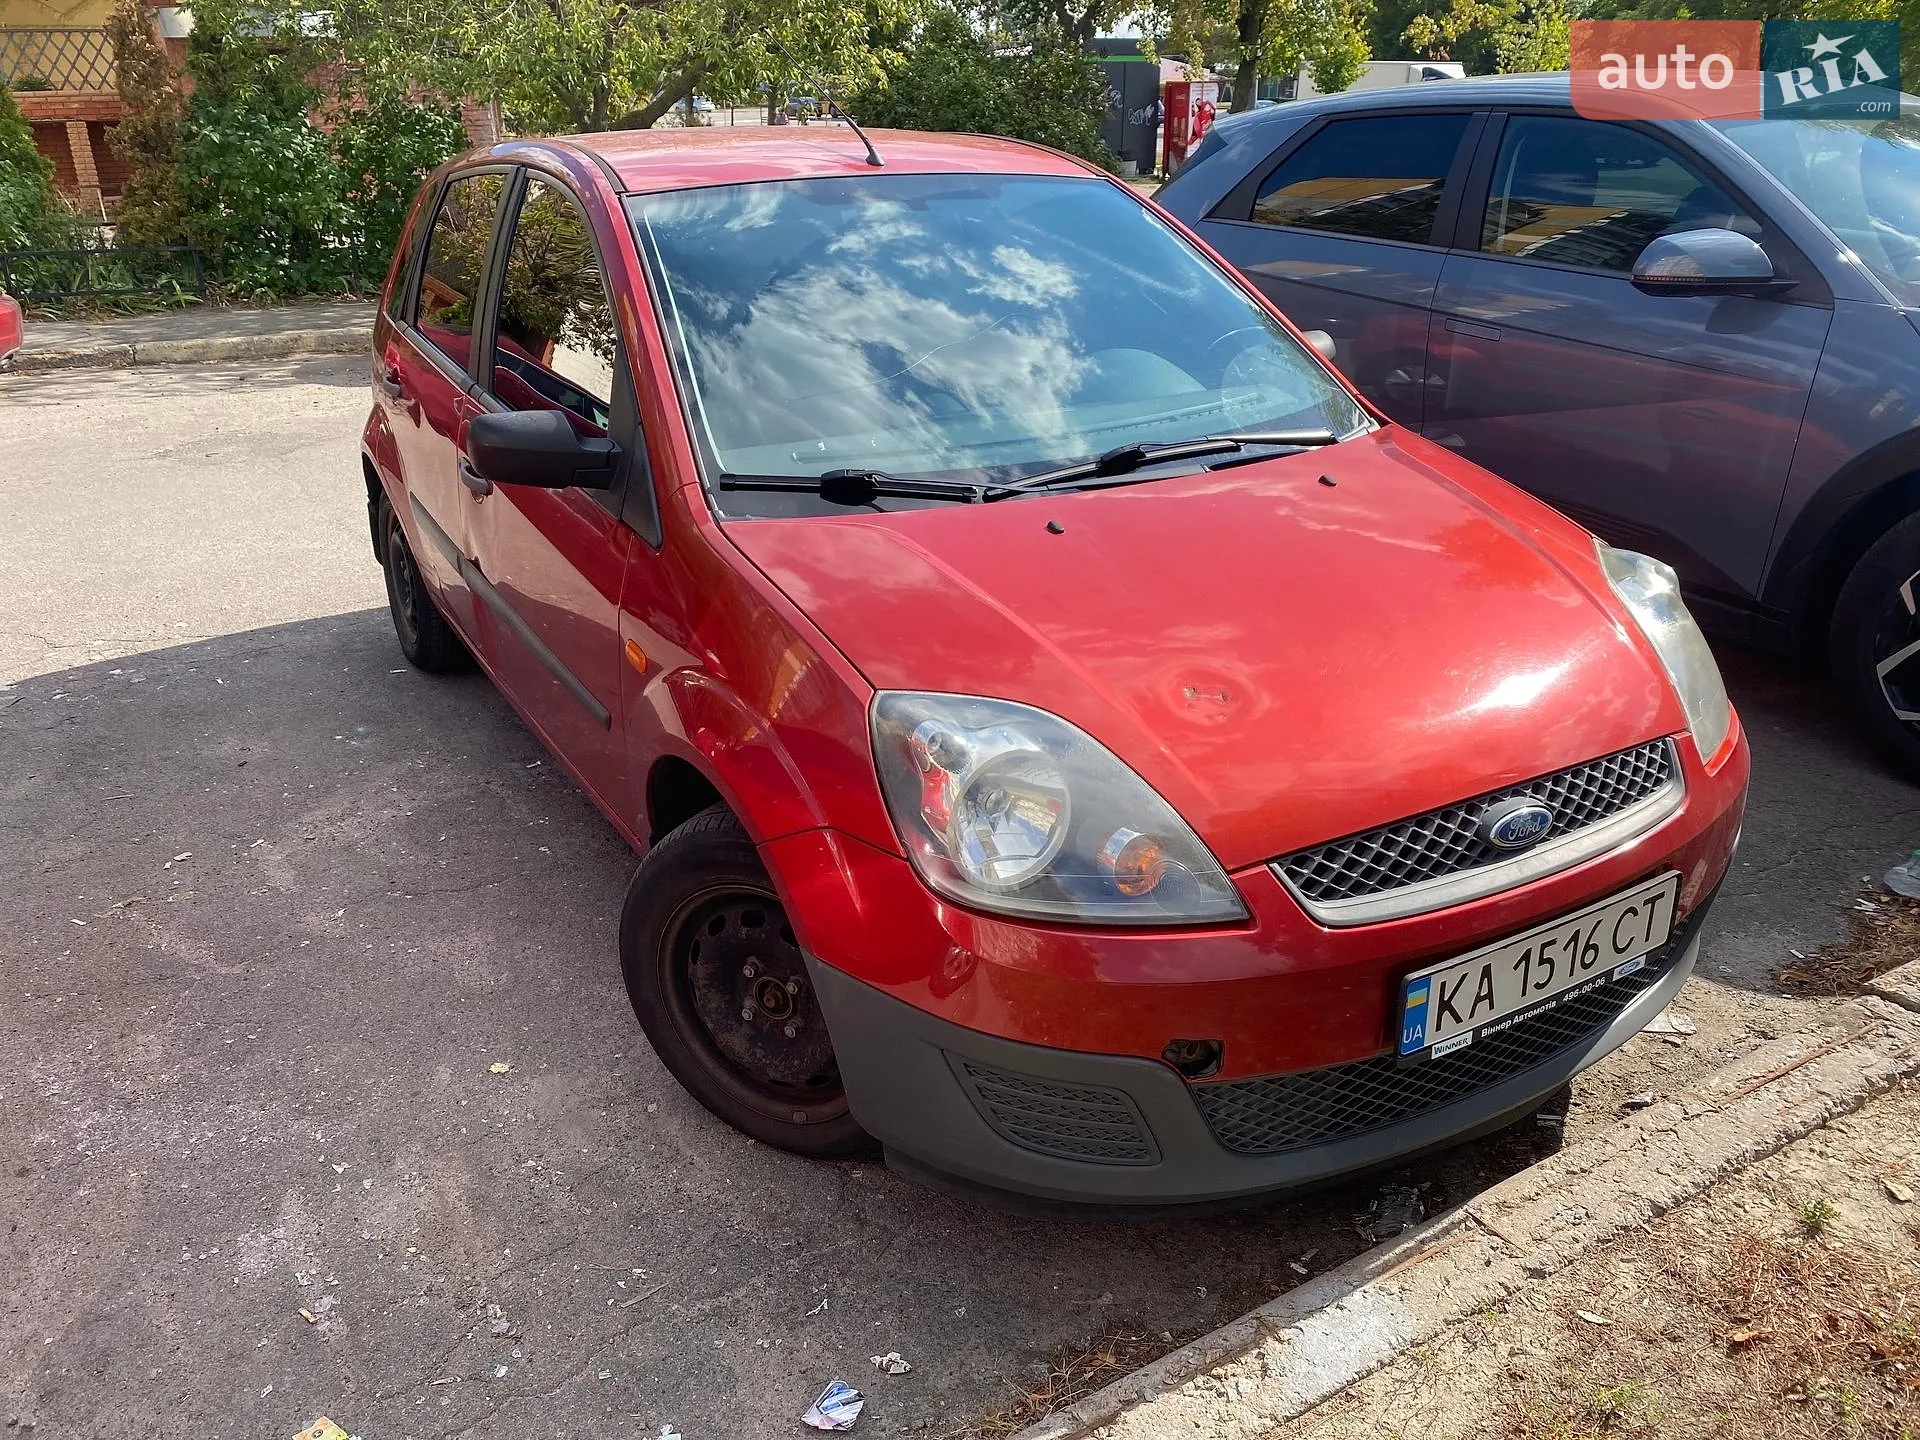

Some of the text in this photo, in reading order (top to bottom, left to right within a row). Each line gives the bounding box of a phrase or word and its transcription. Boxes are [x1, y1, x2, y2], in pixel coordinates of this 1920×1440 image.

[1508, 814, 1542, 841] Ford
[1435, 891, 1666, 1032] KA 1516 CT
[1481, 1020, 1512, 1038] Віннер
[1562, 976, 1606, 1002] 496-00-06
[1402, 1026, 1422, 1043] UA
[1433, 1037, 1469, 1054] WINNER
